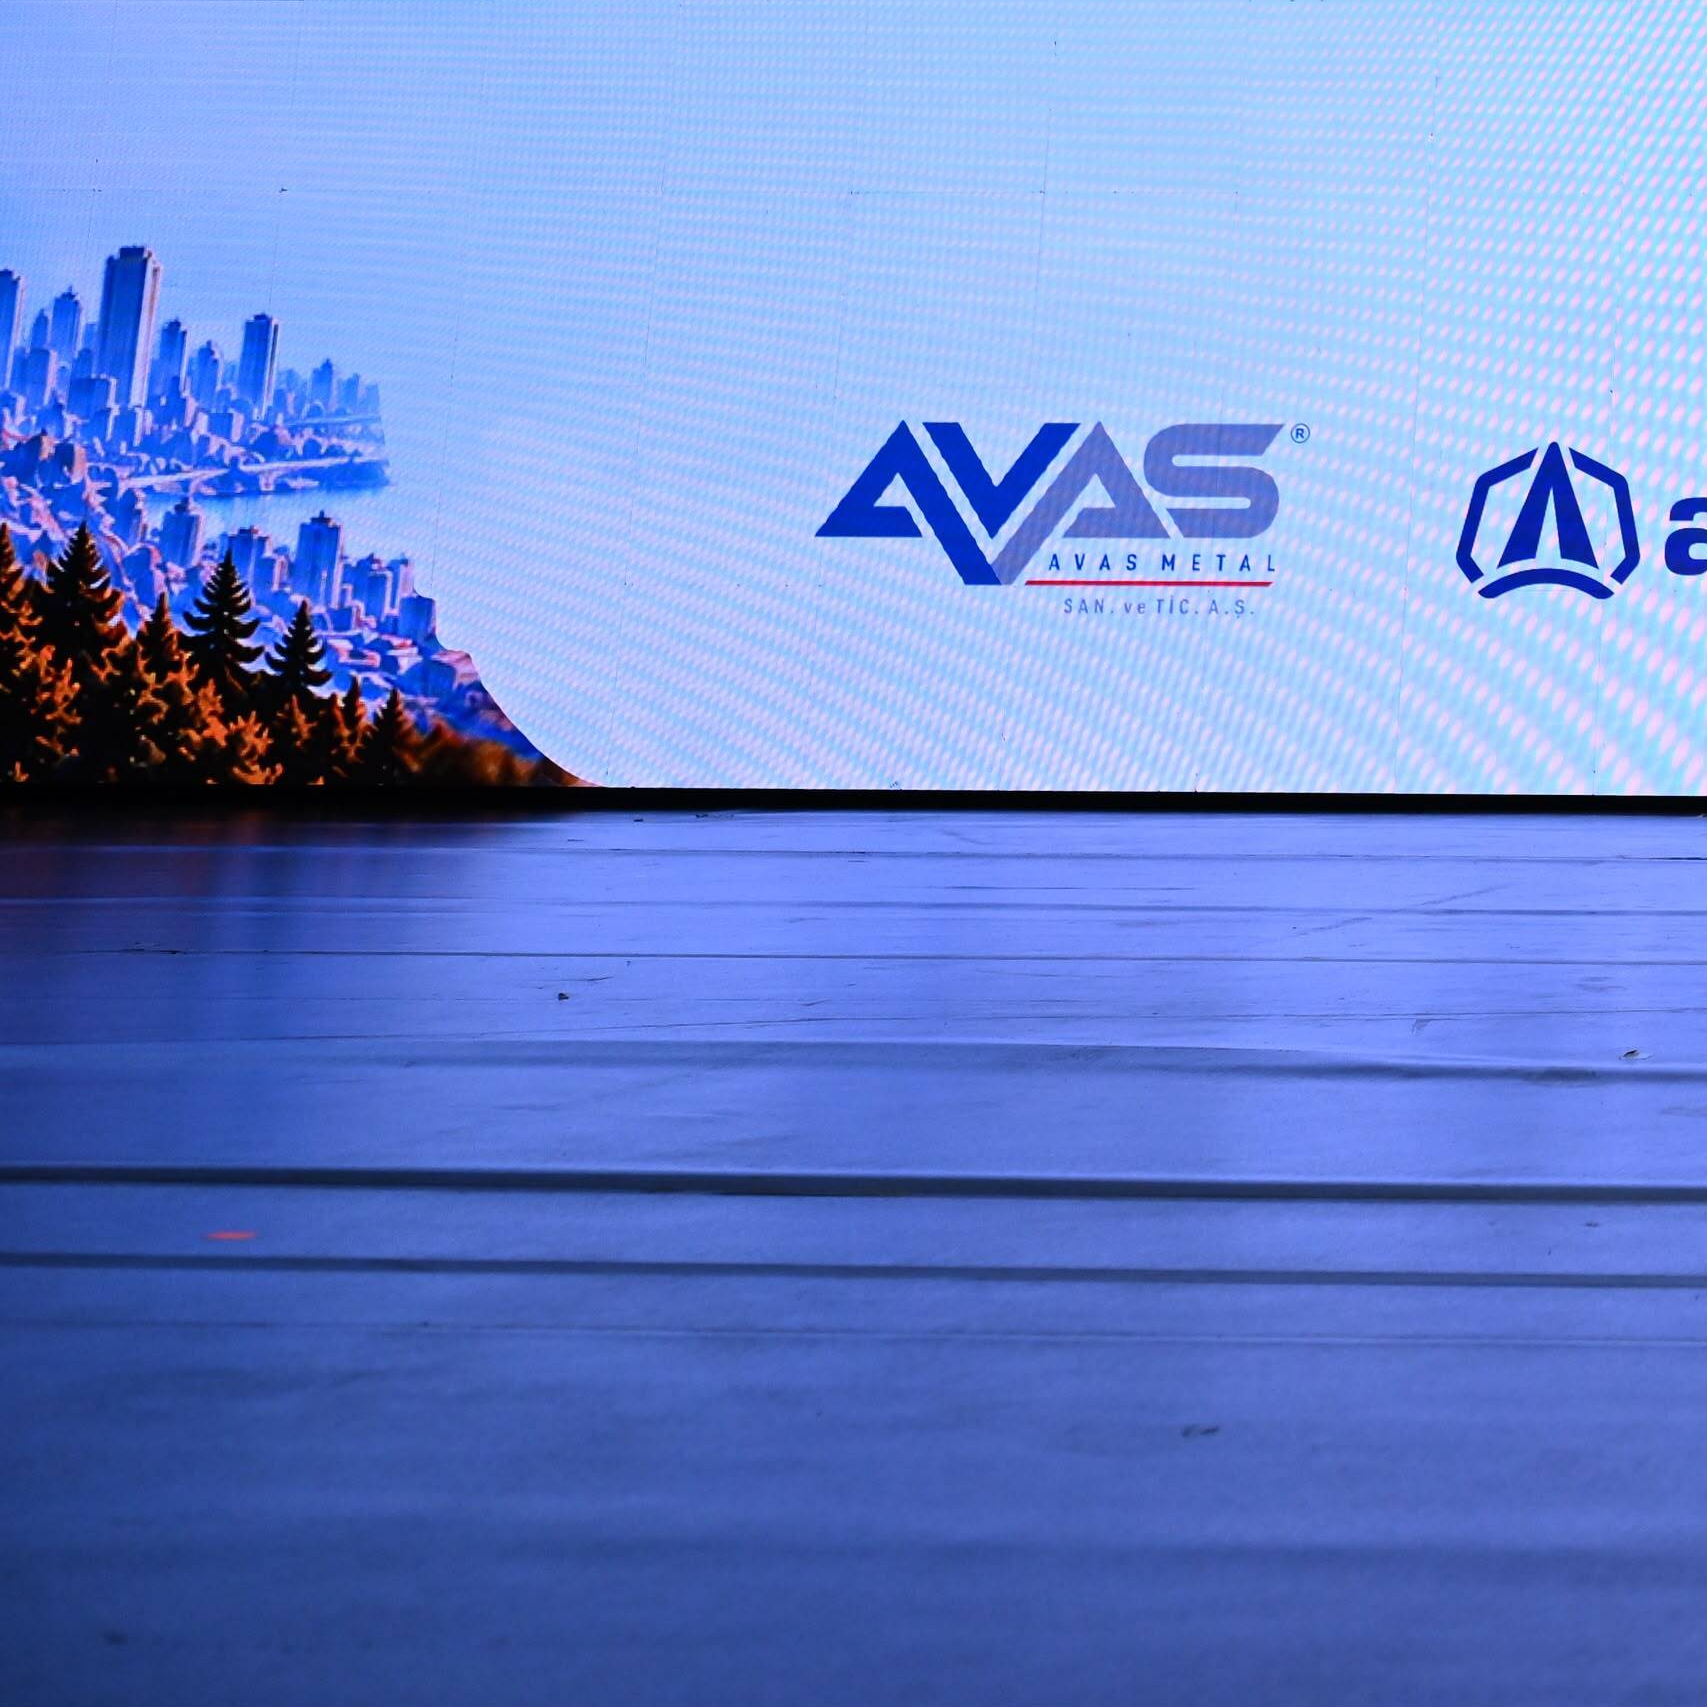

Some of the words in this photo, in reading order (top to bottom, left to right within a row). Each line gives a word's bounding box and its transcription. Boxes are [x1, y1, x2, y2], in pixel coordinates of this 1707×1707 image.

[1049, 553, 1138, 571] AVAS
[1161, 554, 1276, 572] METAL
[1064, 598, 1114, 615] SAN.
[1124, 601, 1147, 615] ve
[1157, 595, 1199, 615] TİC.
[1208, 599, 1255, 619] A.Ş.
